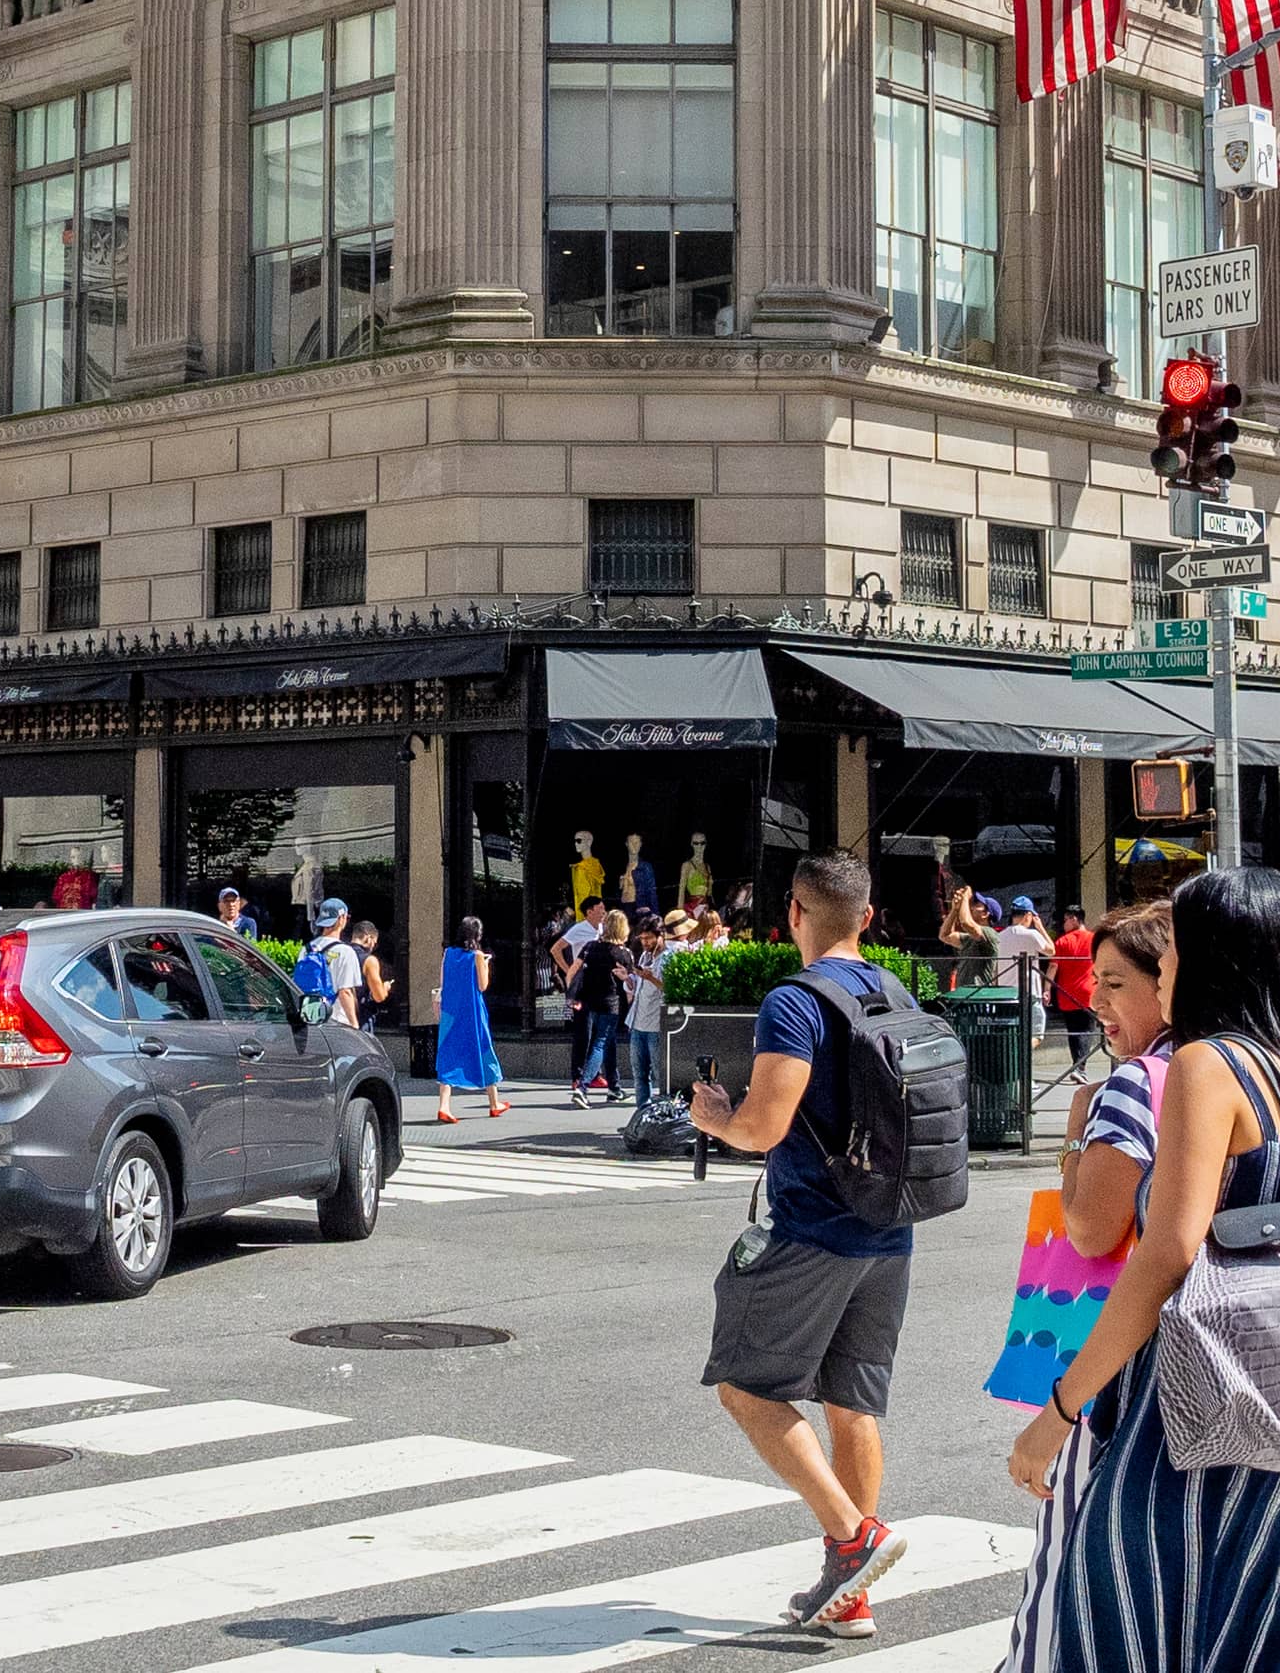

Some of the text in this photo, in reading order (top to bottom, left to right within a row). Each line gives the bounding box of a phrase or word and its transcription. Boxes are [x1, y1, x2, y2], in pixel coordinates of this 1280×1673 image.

[1165, 259, 1251, 294] PASSENGER
[1166, 289, 1251, 323] CARS ONLY
[1209, 515, 1255, 535] ONE WAY
[1178, 557, 1255, 579] ONE WAY
[1243, 592, 1250, 615] 5
[1163, 621, 1201, 638] E 50
[1168, 637, 1197, 648] STREET
[1073, 651, 1204, 671] JOHN CARDINAL O'CONNOR
[602, 722, 724, 745] Saks Fifth Avenue
